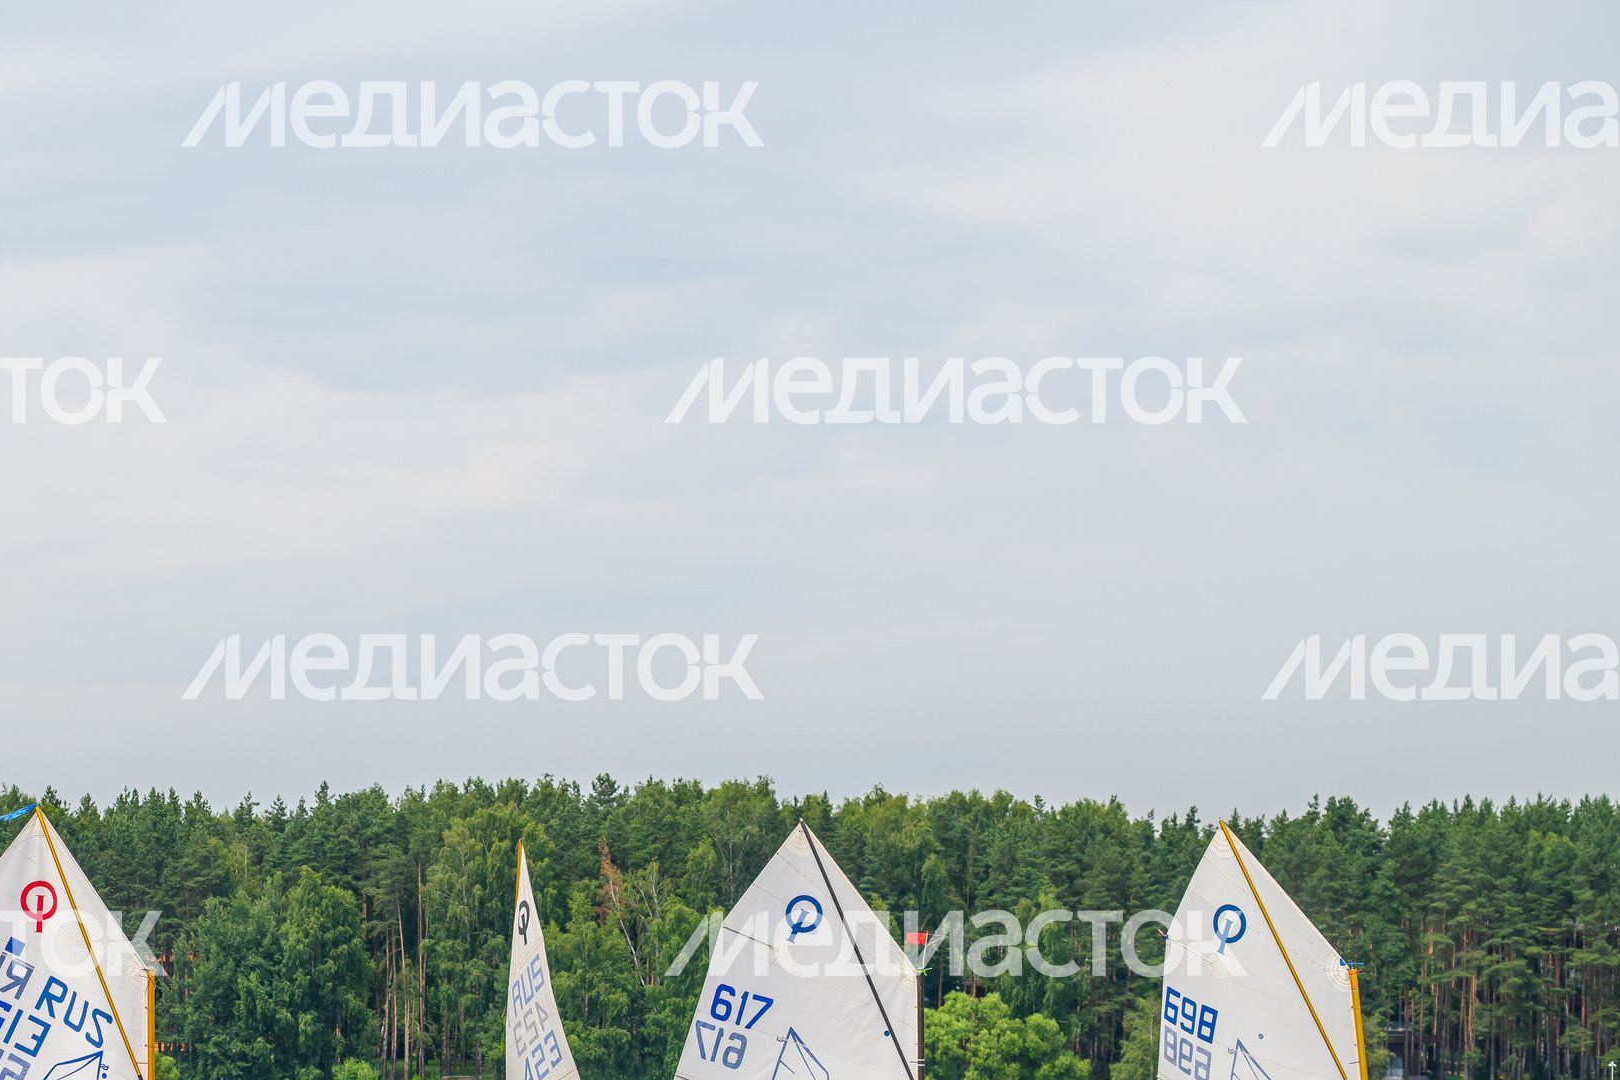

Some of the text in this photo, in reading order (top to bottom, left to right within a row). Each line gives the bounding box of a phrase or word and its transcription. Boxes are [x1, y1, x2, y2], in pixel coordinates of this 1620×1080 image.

[35, 975, 114, 1048] RUS
[511, 953, 545, 1018] RUS
[710, 983, 774, 1029] 617
[1163, 985, 1219, 1044] 698
